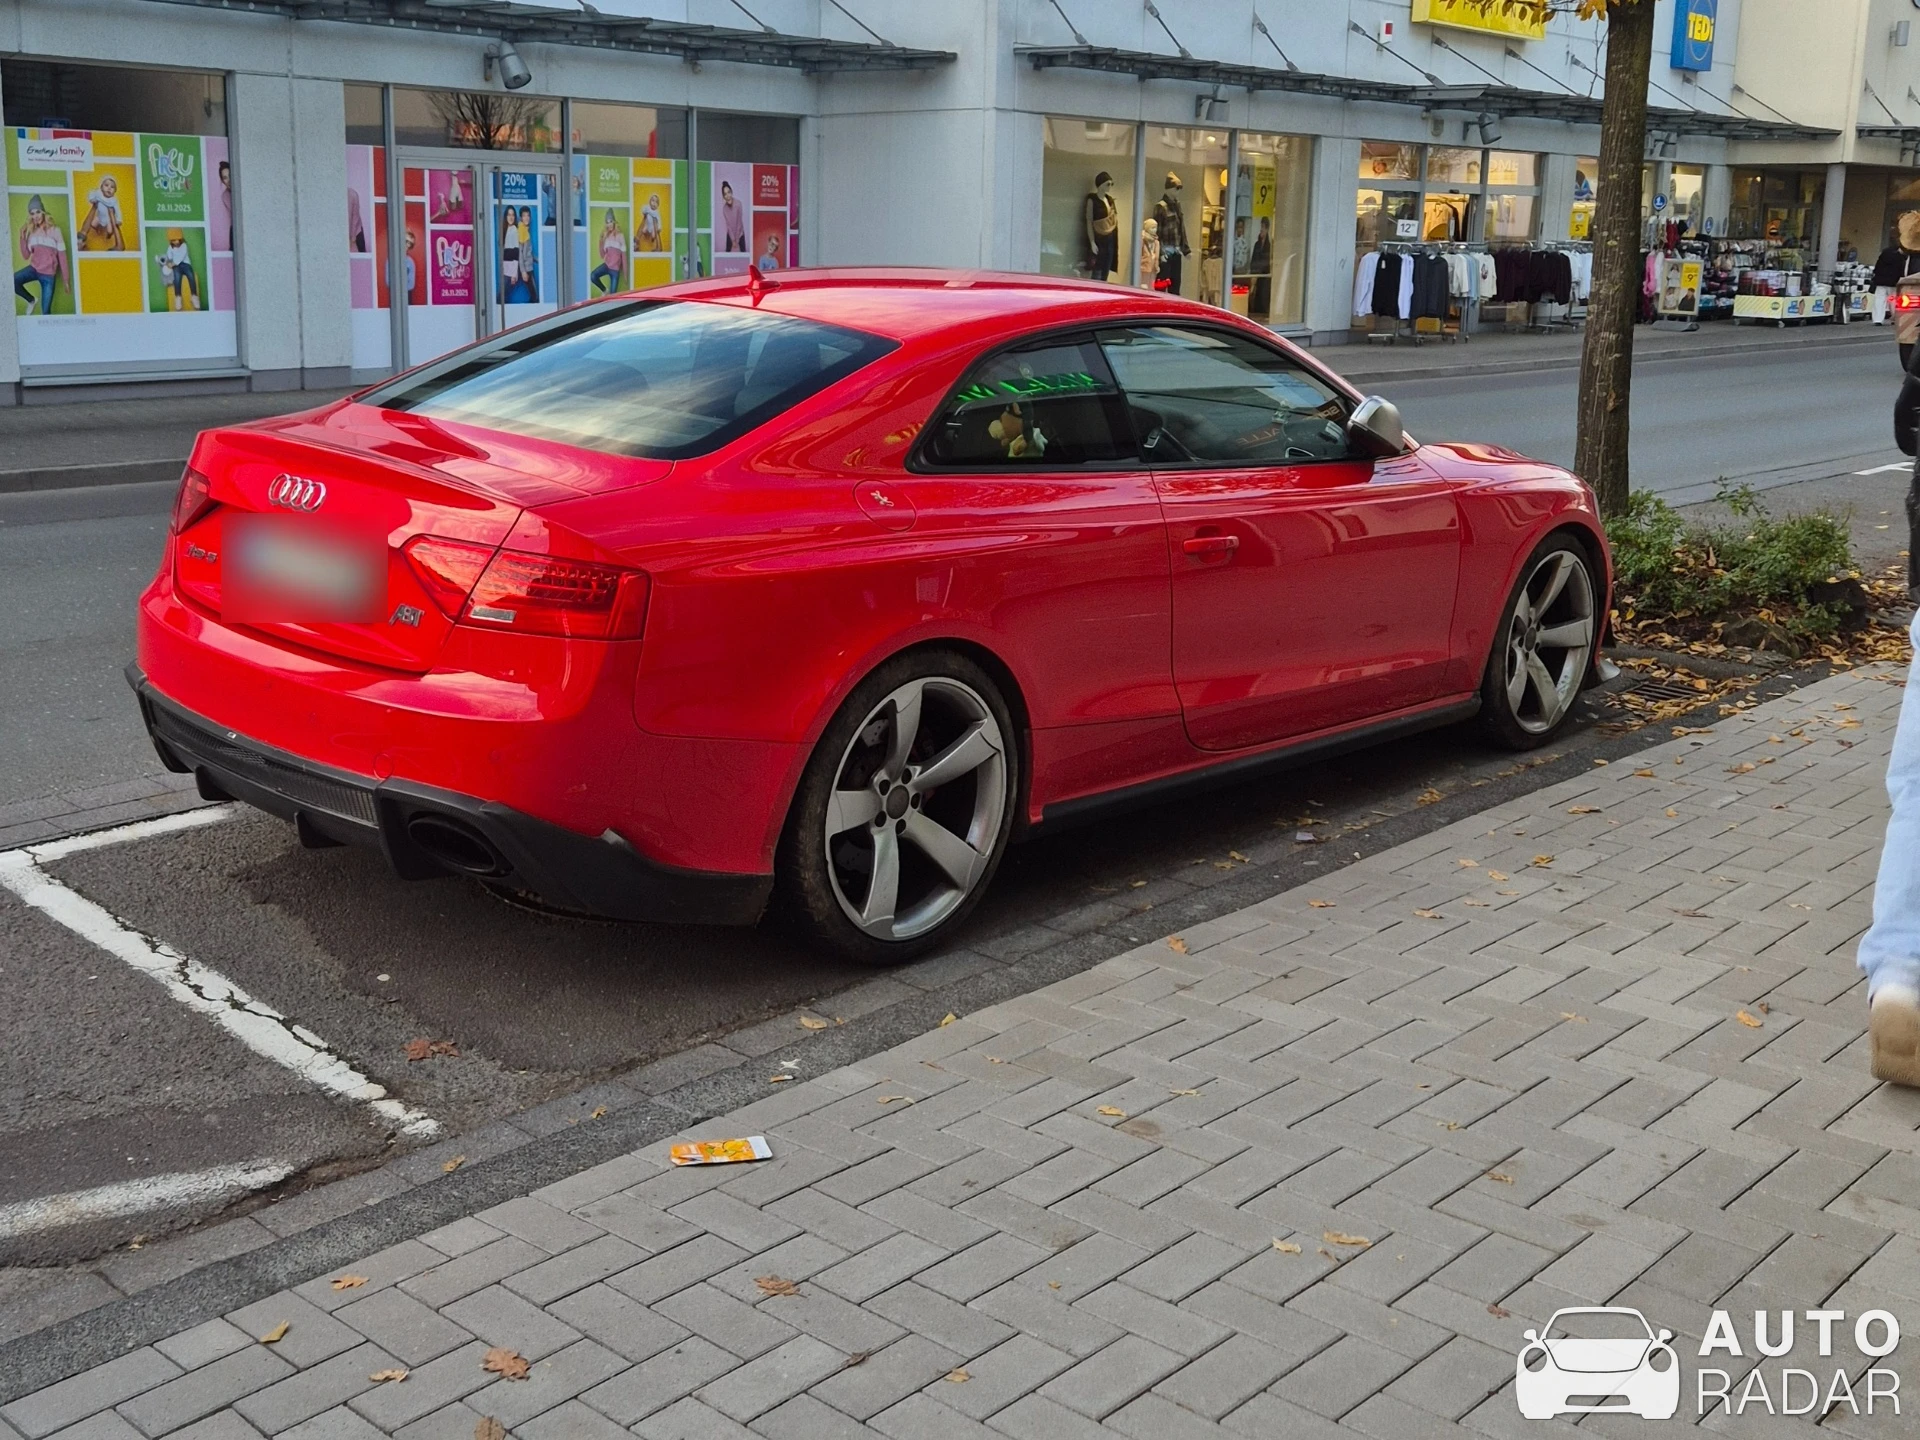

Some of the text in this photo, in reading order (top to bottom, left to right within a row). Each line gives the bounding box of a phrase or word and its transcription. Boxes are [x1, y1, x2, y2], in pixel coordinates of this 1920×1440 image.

[1688, 11, 1714, 42] TEDi
[59, 145, 85, 157] family
[504, 173, 527, 187] 20%
[599, 168, 620, 181] 20%
[761, 174, 780, 187] 20%
[156, 203, 192, 213] 28.11.2025
